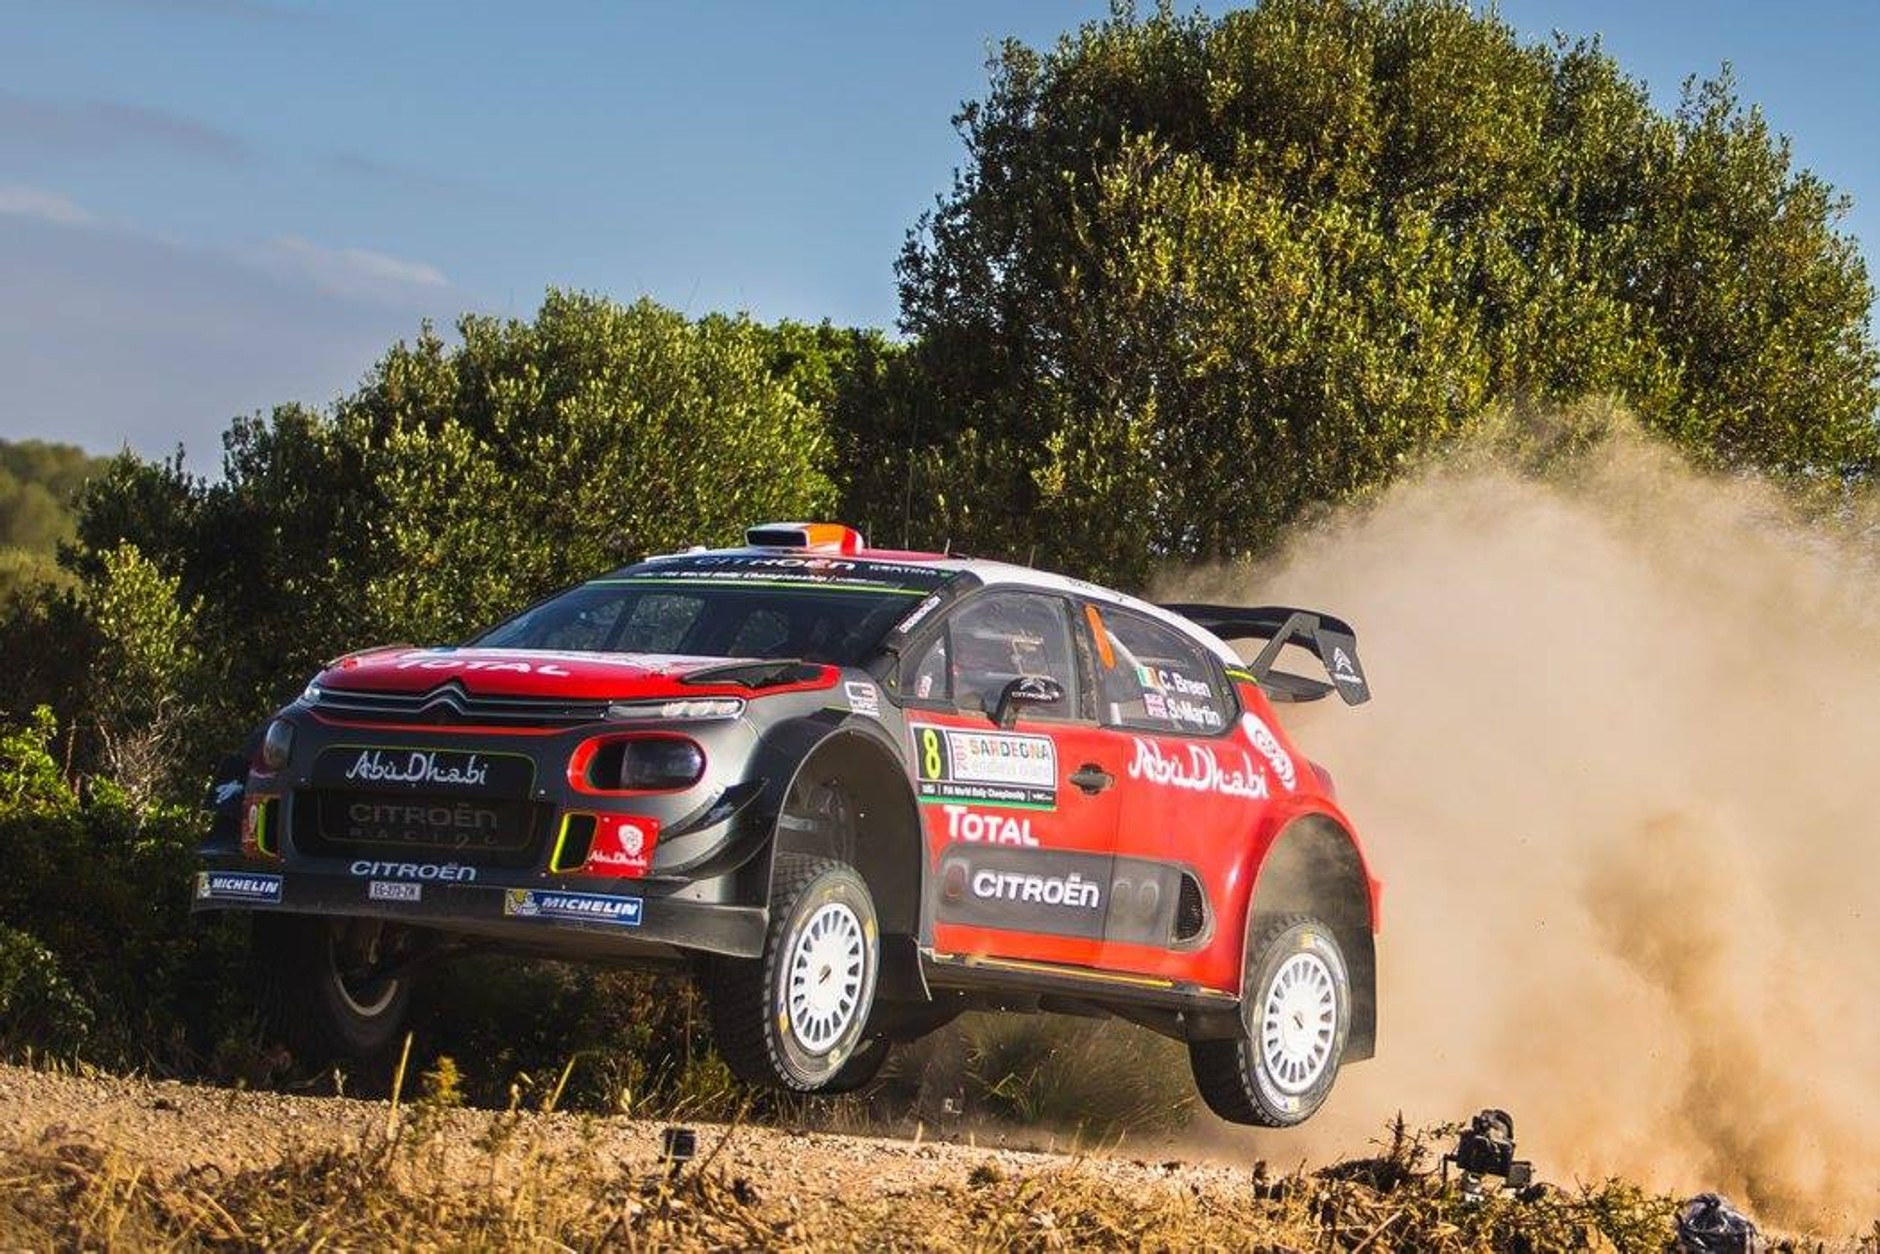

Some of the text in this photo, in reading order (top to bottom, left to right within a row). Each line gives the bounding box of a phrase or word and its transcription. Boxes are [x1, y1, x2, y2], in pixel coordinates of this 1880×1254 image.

[1171, 672, 1212, 698] Breen
[923, 728, 941, 780] 8
[971, 739, 1050, 760] SARDEGNA
[944, 805, 1039, 847] TOTAL
[350, 861, 476, 881] CITROËN
[212, 878, 279, 893] MICHELIN
[973, 873, 1100, 908] CITROËN
[543, 896, 638, 915] MICHELIN
